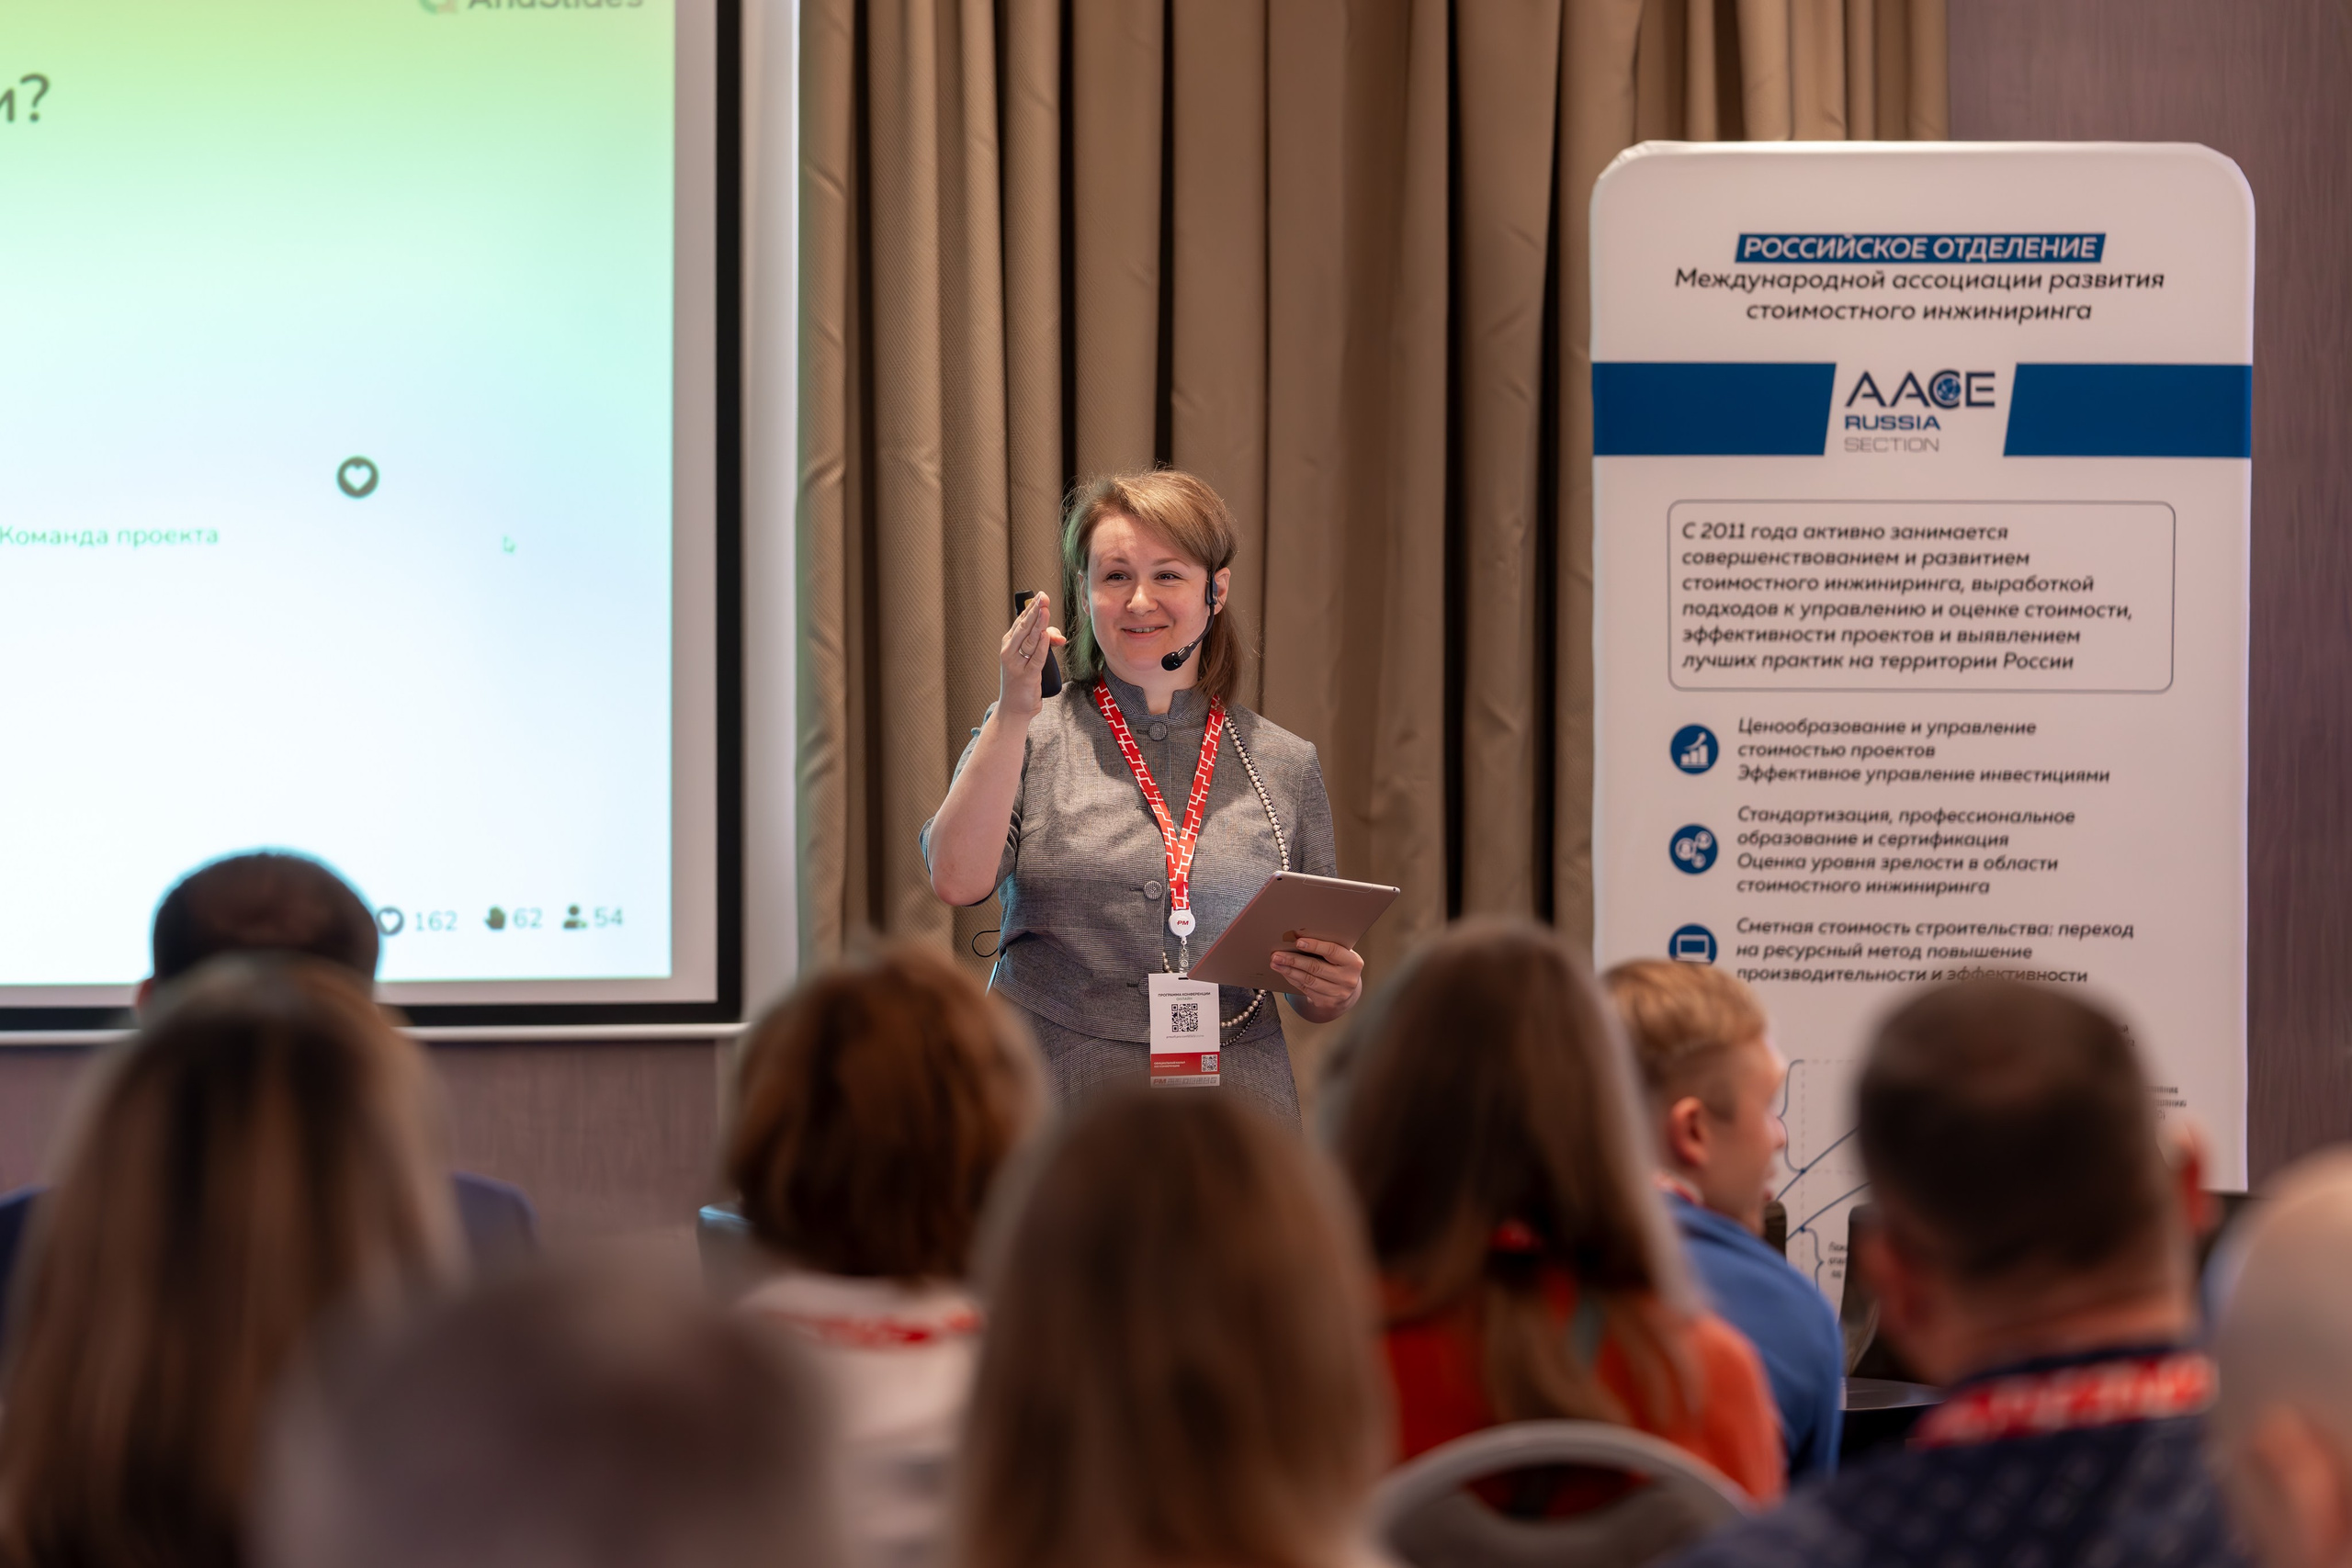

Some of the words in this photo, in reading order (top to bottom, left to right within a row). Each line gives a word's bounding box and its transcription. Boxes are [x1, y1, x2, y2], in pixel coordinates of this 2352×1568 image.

[1743, 234, 1928, 260] РОССИЙСКОЕ
[1932, 236, 2098, 262] ОТДЕЛЕНИЕ
[1674, 266, 1886, 295] Международной
[1892, 274, 2043, 292] ассоциации
[2048, 273, 2165, 295] развития
[1746, 304, 1917, 321] стоимостного
[1922, 304, 2093, 326] инжиниринга
[1845, 369, 1996, 410] AACE
[1844, 415, 1941, 431] RUSSIA
[1844, 436, 1939, 452] SECTION
[0, 525, 109, 548] Команда
[117, 528, 220, 549] проекта
[1681, 521, 1697, 540] С
[1700, 522, 1746, 540] 2011
[1750, 525, 1799, 542] года
[1803, 525, 1886, 540] активно
[1889, 526, 2009, 541] занимается
[1681, 551, 1900, 570] совершенствованием
[1904, 552, 1917, 566] и
[1920, 552, 2030, 570] развитием
[1681, 577, 1820, 592] стоимостного
[1824, 578, 1965, 596] инжиниринга,
[1971, 574, 2095, 597] выработкой
[1681, 603, 1780, 619] подходов
[1783, 603, 1795, 616] к
[1799, 603, 1928, 622] управлению
[1930, 604, 1944, 617] и
[1948, 604, 2020, 620] оценке
[2024, 604, 2132, 621] стоимости,
[1682, 625, 1837, 647] эффективности
[1840, 629, 1935, 648] проектов
[1939, 630, 1952, 643] и
[1956, 629, 2081, 645] выявлением
[1681, 654, 1758, 673] лучших
[1761, 654, 1845, 672] практик
[1848, 654, 1874, 670] на
[1879, 655, 1998, 674] территории
[2002, 650, 2075, 671] России
[1737, 716, 1907, 738] Ценообразование
[1910, 722, 1923, 735] и
[1925, 722, 2038, 739] управление
[1736, 744, 1847, 759] стоимостью
[1849, 745, 1937, 762] проектов
[1737, 763, 1862, 784] Эффективное
[1864, 768, 1976, 786] управление
[1979, 769, 2110, 785] инвестициями
[1736, 805, 1894, 827] Стандартизация,
[1898, 807, 2076, 828] профессиональное
[1736, 829, 1859, 850] образование
[1861, 834, 1874, 847] и
[1877, 830, 2010, 851] сертификация
[1736, 852, 1807, 872] Оценка
[1810, 856, 1877, 874] уровня
[1880, 857, 1964, 874] зрелости
[1967, 858, 1979, 872] в
[1983, 854, 2059, 872] области
[1736, 879, 1862, 894] стоимостного
[1865, 881, 1991, 898] инжиниринга
[415, 910, 458, 931] 162
[513, 907, 543, 929] 62
[594, 906, 624, 928] 54
[1736, 917, 1815, 935] Сметная
[1817, 921, 1912, 936] стоимость
[1915, 922, 2054, 940] строительства:
[2057, 923, 2134, 942] переход
[1736, 944, 1760, 958] на
[1762, 942, 1863, 963] ресурсный
[1867, 945, 1923, 962] метод
[1926, 946, 2033, 960] повышение
[1736, 967, 1927, 985] производительности
[1931, 969, 1942, 981] и
[1947, 964, 2088, 986] эффективности
